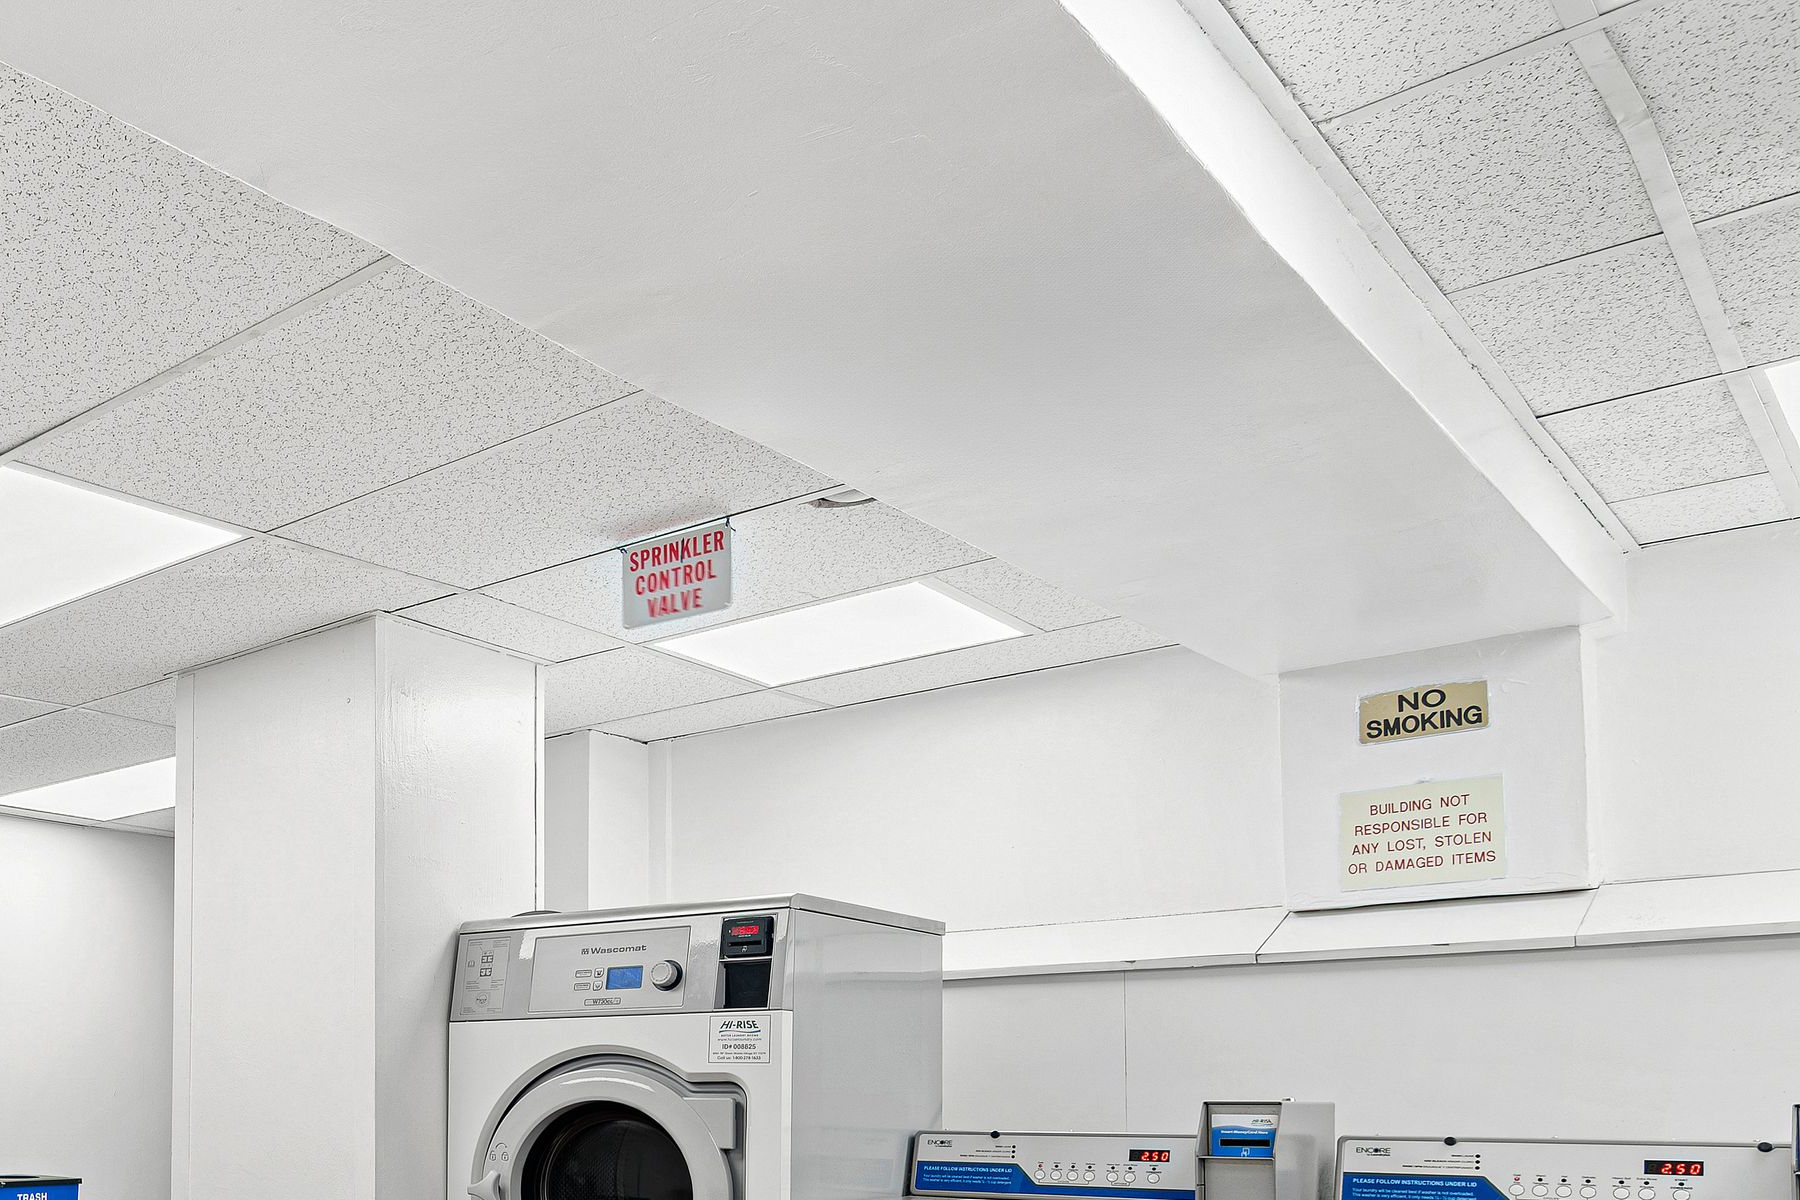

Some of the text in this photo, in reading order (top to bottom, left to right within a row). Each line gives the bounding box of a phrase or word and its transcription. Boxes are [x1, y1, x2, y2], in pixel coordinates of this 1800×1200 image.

[629, 530, 724, 572] SPRINKLER
[635, 559, 717, 596] CONTROL
[647, 588, 704, 618] VALVE
[1397, 688, 1446, 713] NO
[1366, 705, 1483, 739] SMOKING
[1369, 793, 1470, 816] BUILDING NOT
[1354, 812, 1488, 836] RESPONSIBLE FOR
[1352, 831, 1492, 856] ANY LOST, STOLEN
[1348, 850, 1496, 875] OR DAMAGED ITEMS
[591, 945, 647, 954] Wascomat
[720, 1021, 758, 1029] HI-RISE
[1141, 1151, 1169, 1161] 2.50
[1661, 1163, 1700, 1175] 2.50
